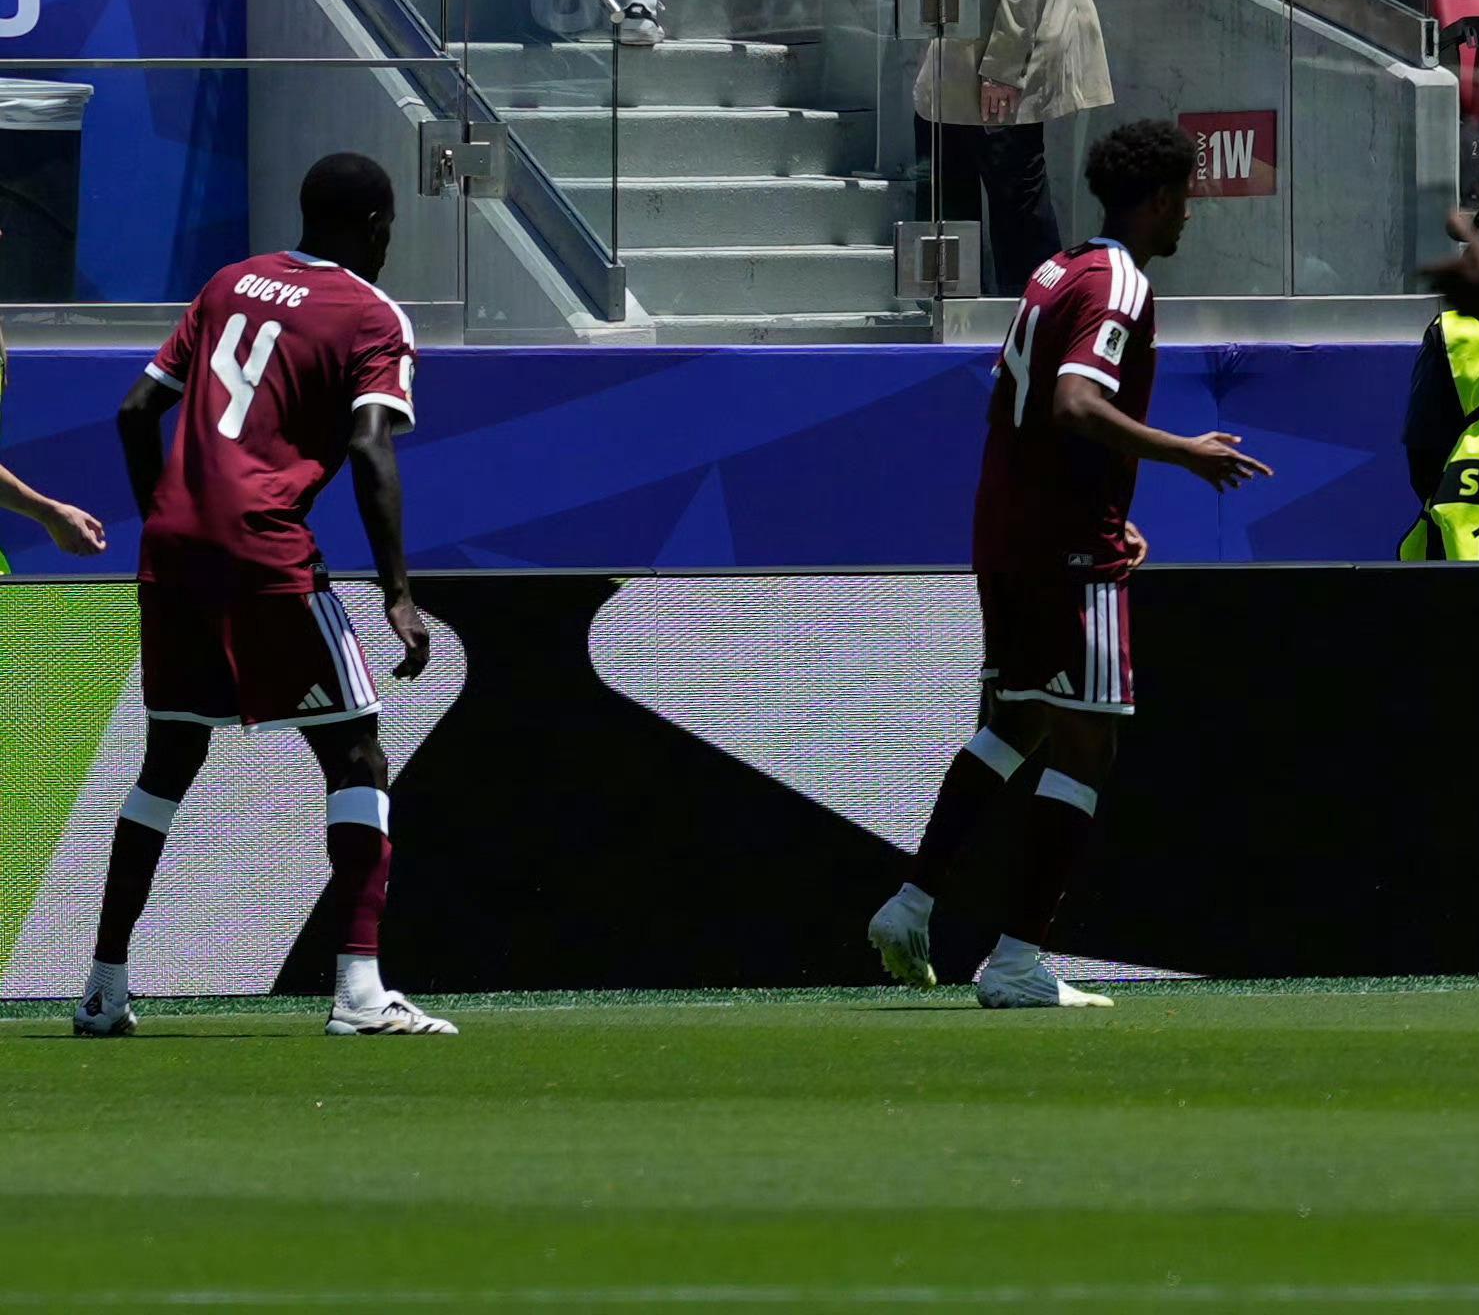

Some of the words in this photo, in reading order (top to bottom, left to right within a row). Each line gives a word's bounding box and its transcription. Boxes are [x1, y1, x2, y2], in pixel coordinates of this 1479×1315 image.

[1196, 132, 1208, 180] ROW
[1208, 128, 1255, 181] 1W
[209, 312, 282, 440] 4
